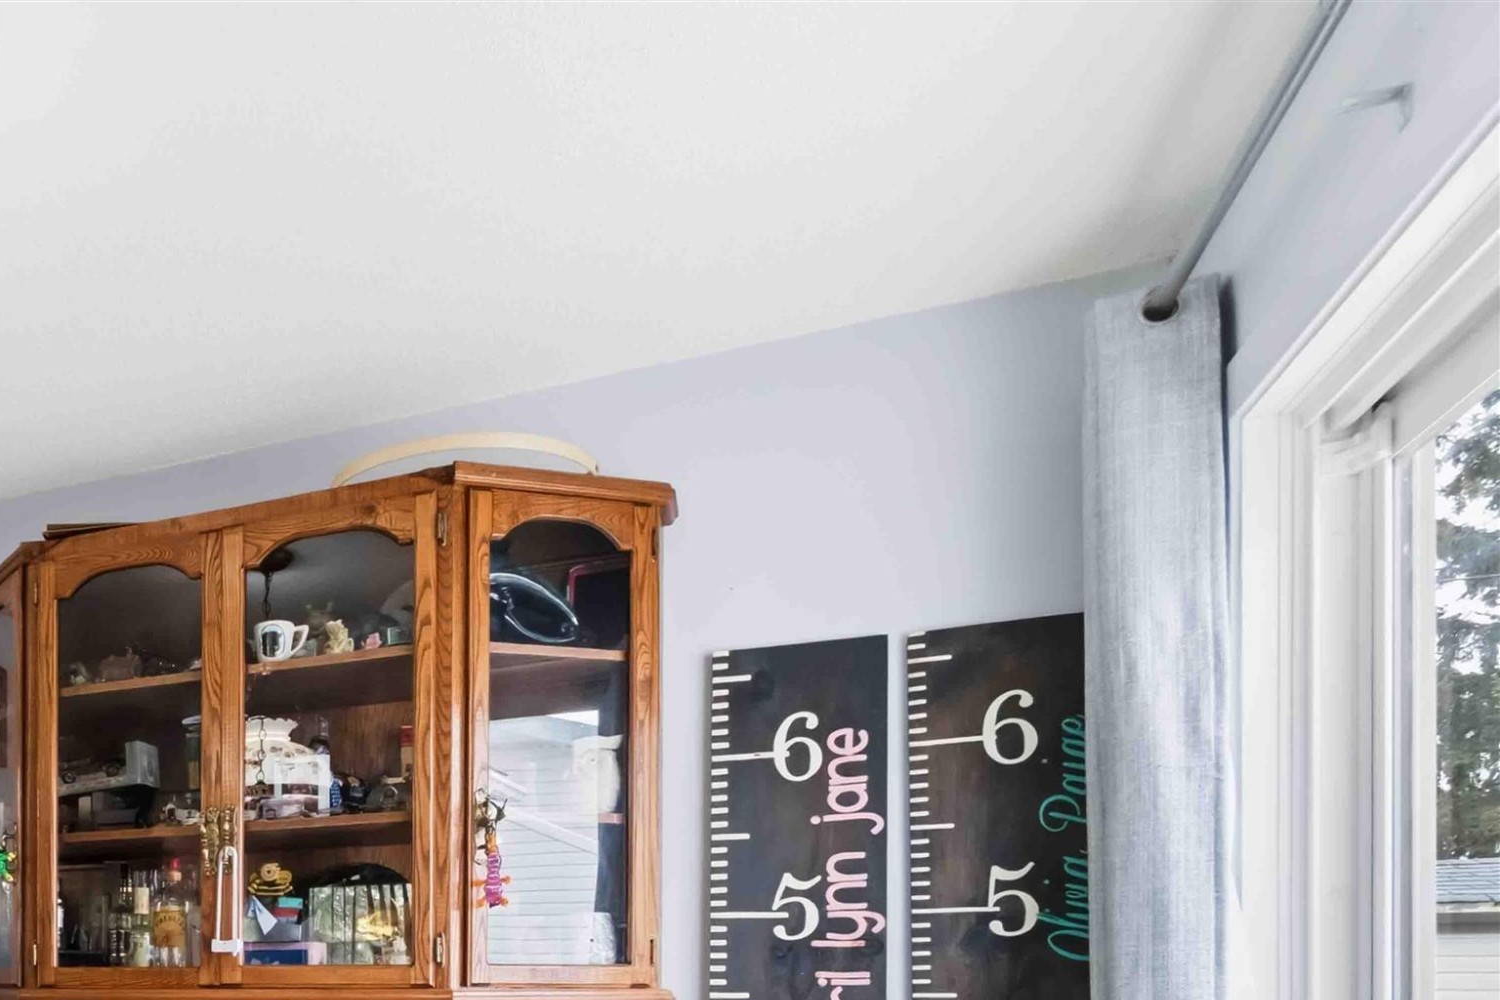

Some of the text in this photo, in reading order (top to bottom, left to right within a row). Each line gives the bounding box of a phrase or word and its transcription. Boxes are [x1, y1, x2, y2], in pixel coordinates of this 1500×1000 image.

[773, 711, 823, 781] 6
[982, 689, 1038, 765] 6
[810, 727, 885, 836] jane
[772, 872, 822, 942] 5
[811, 850, 886, 949] lynn
[987, 861, 1040, 937] 5
